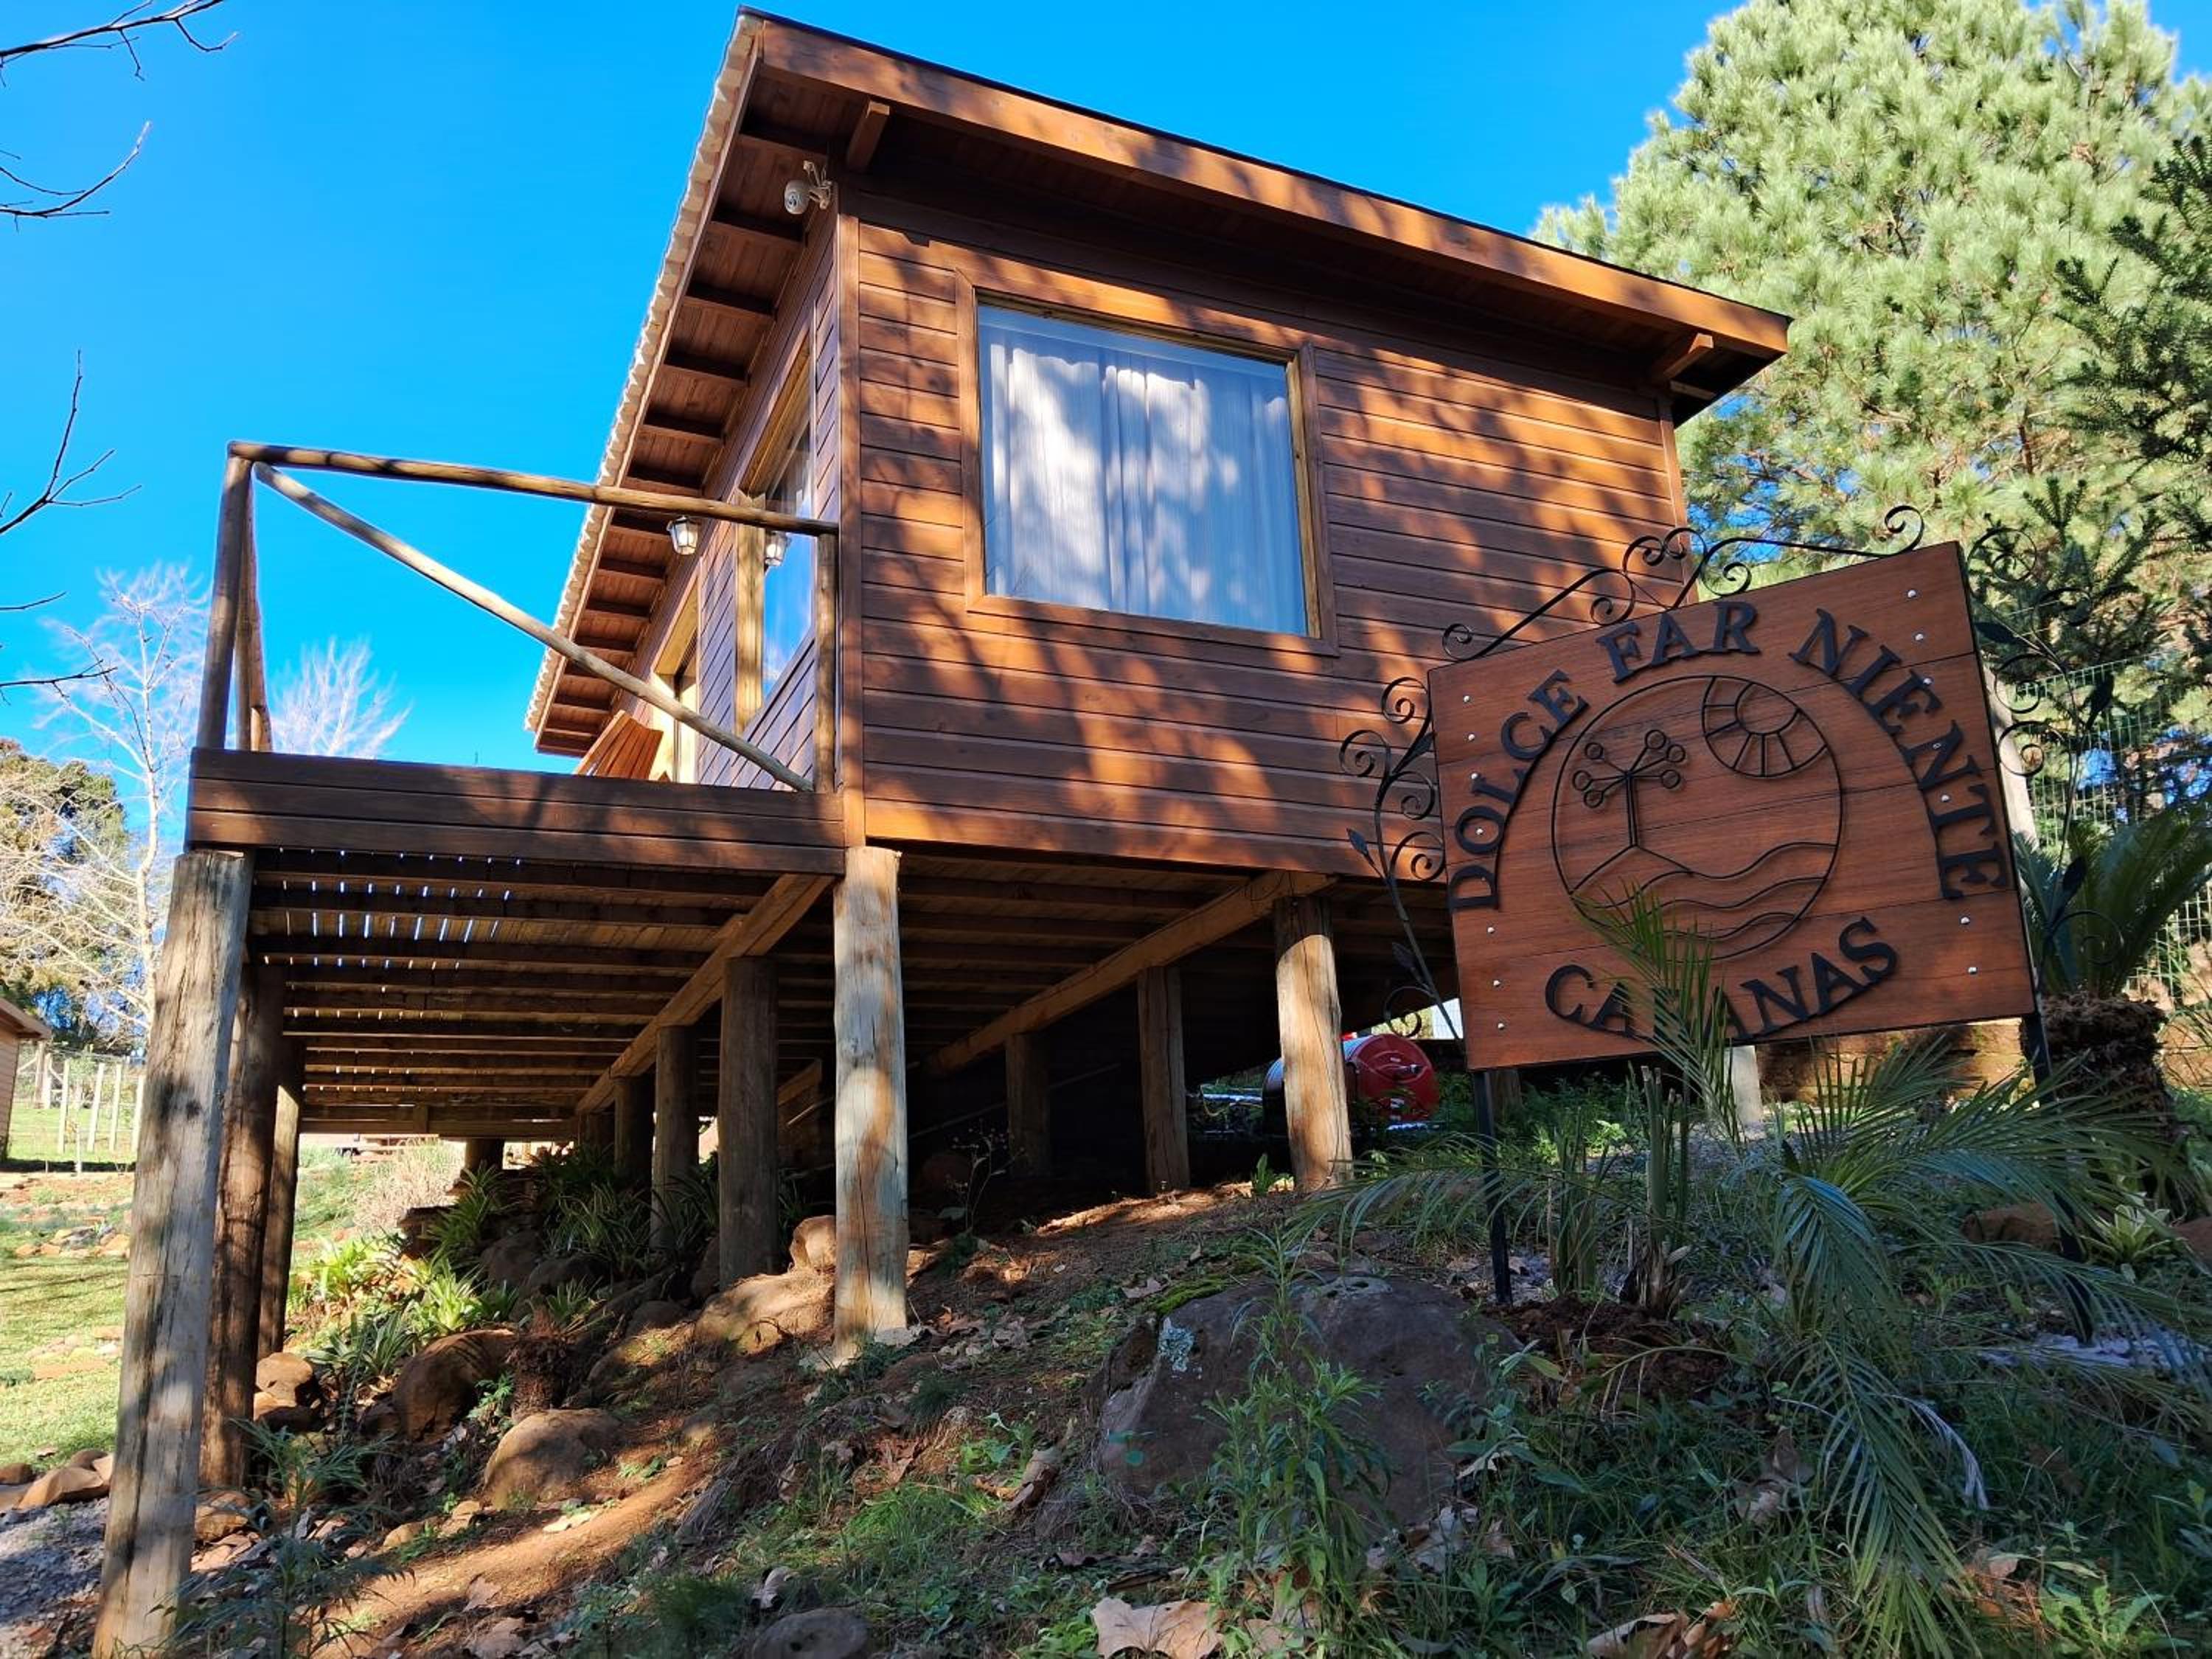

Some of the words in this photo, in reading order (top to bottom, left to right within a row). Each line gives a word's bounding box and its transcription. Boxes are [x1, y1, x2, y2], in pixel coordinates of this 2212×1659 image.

[1448, 669, 1589, 911] DOLCE
[1597, 600, 1760, 684] FAR
[1789, 608, 2007, 900] NIENTE
